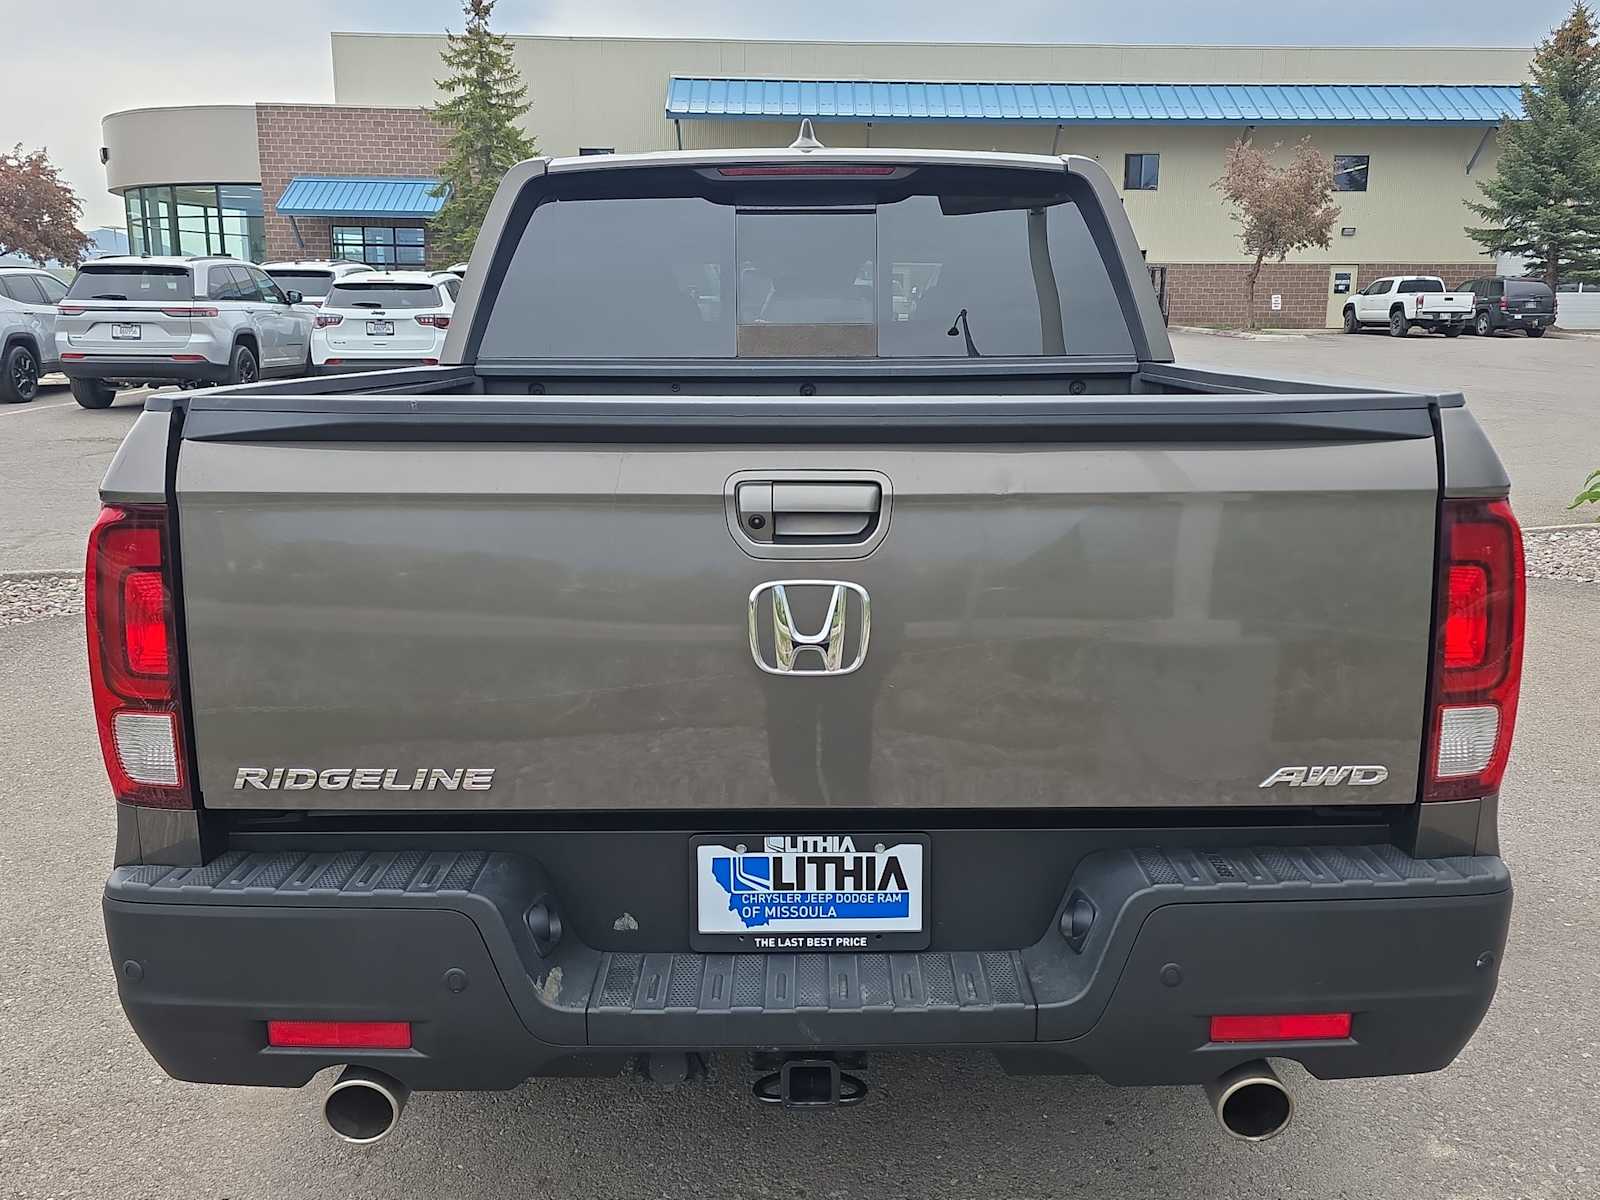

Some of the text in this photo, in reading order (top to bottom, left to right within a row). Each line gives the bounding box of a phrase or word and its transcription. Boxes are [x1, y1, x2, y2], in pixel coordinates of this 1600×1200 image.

[233, 767, 496, 791] RIDGELINE
[1258, 765, 1389, 788] AWD
[785, 836, 856, 853] LITHIA
[772, 855, 909, 891] LITHIA
[742, 893, 902, 904] CHRYSLER JEEP DODGE RAM
[742, 906, 837, 918] OF MISSOULA
[754, 937, 868, 948] THE LAST BEST PRICE
